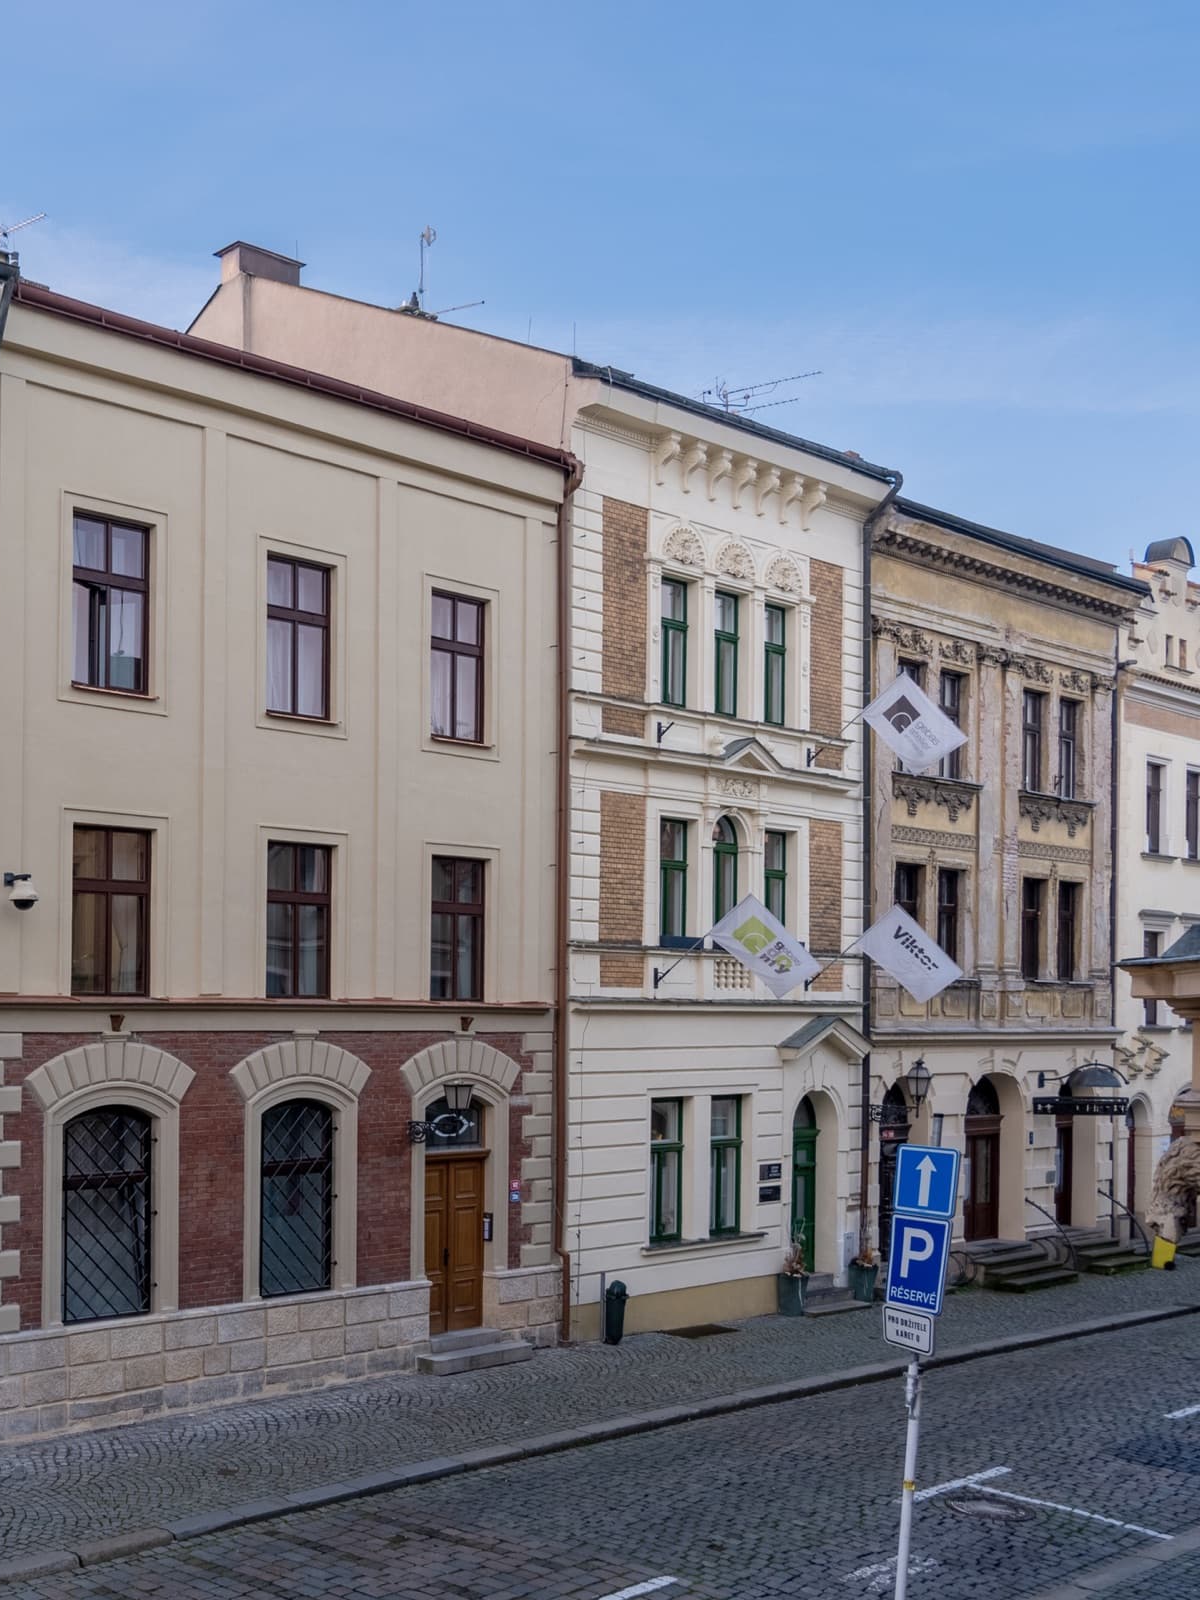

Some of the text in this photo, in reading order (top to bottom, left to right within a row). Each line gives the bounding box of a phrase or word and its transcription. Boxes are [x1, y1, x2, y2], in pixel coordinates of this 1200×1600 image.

[893, 925, 939, 970] Viktor
[900, 1227, 934, 1278] P
[890, 1285, 937, 1305] RÉSERVÉ
